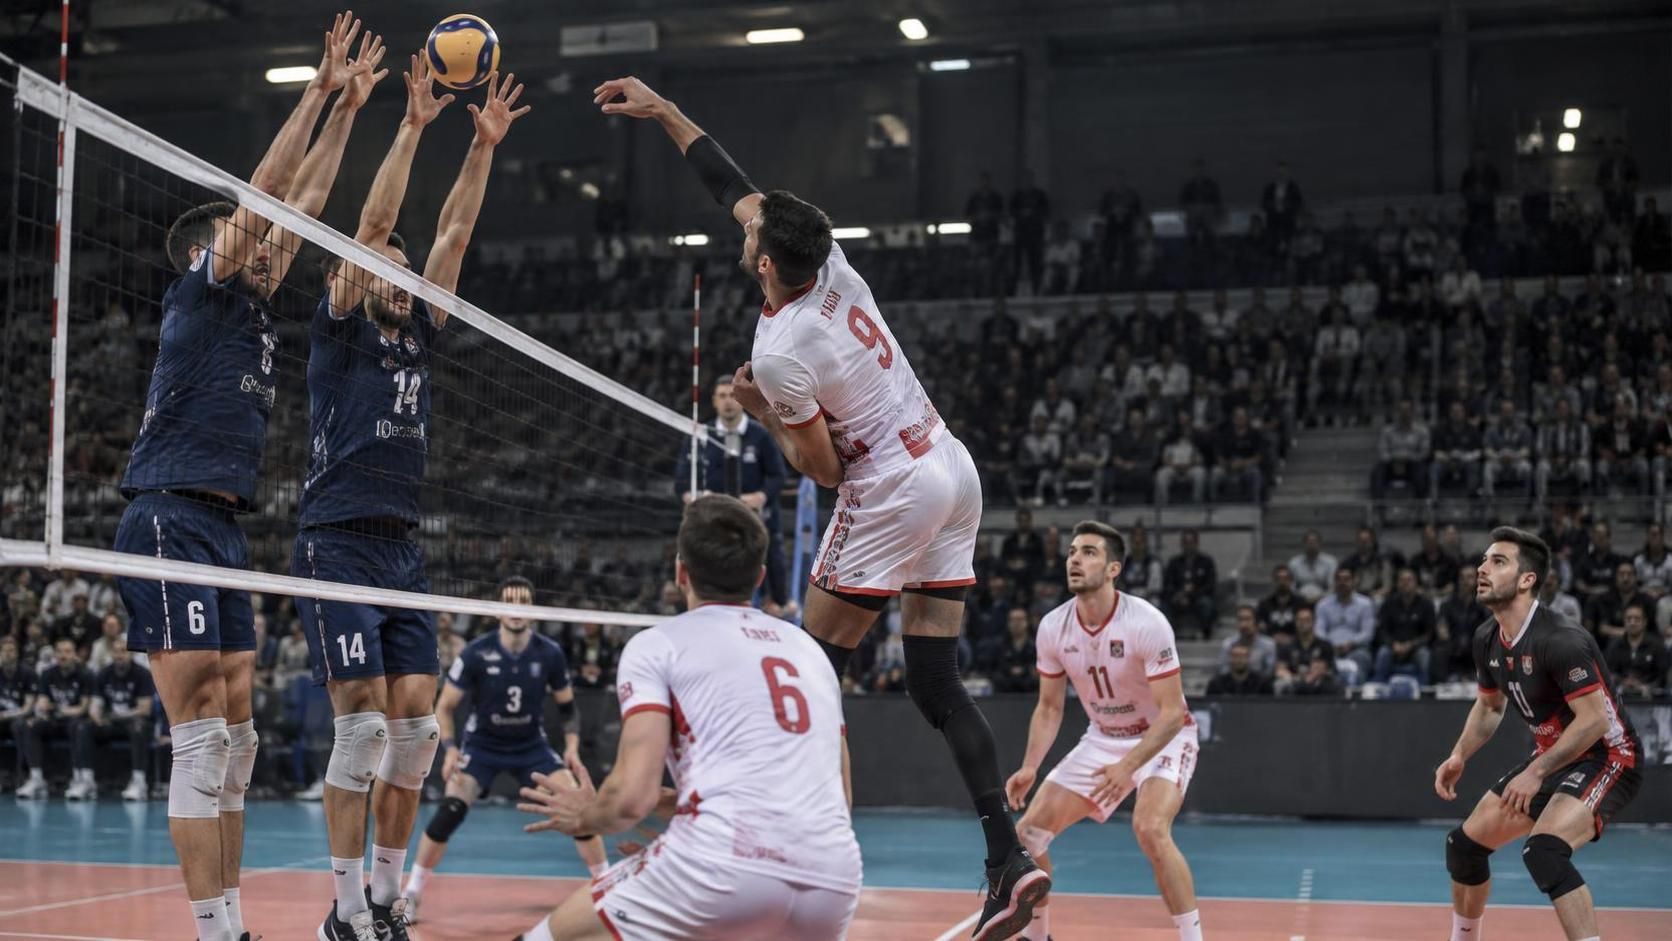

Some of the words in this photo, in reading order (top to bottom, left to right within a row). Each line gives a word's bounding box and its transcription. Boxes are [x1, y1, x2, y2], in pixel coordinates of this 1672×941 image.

[847, 304, 893, 370] 9
[393, 369, 421, 415] 14
[187, 600, 205, 635] 6
[336, 632, 366, 667] 14
[506, 686, 522, 713] 3
[761, 656, 811, 735] 6
[1087, 666, 1115, 699] 11
